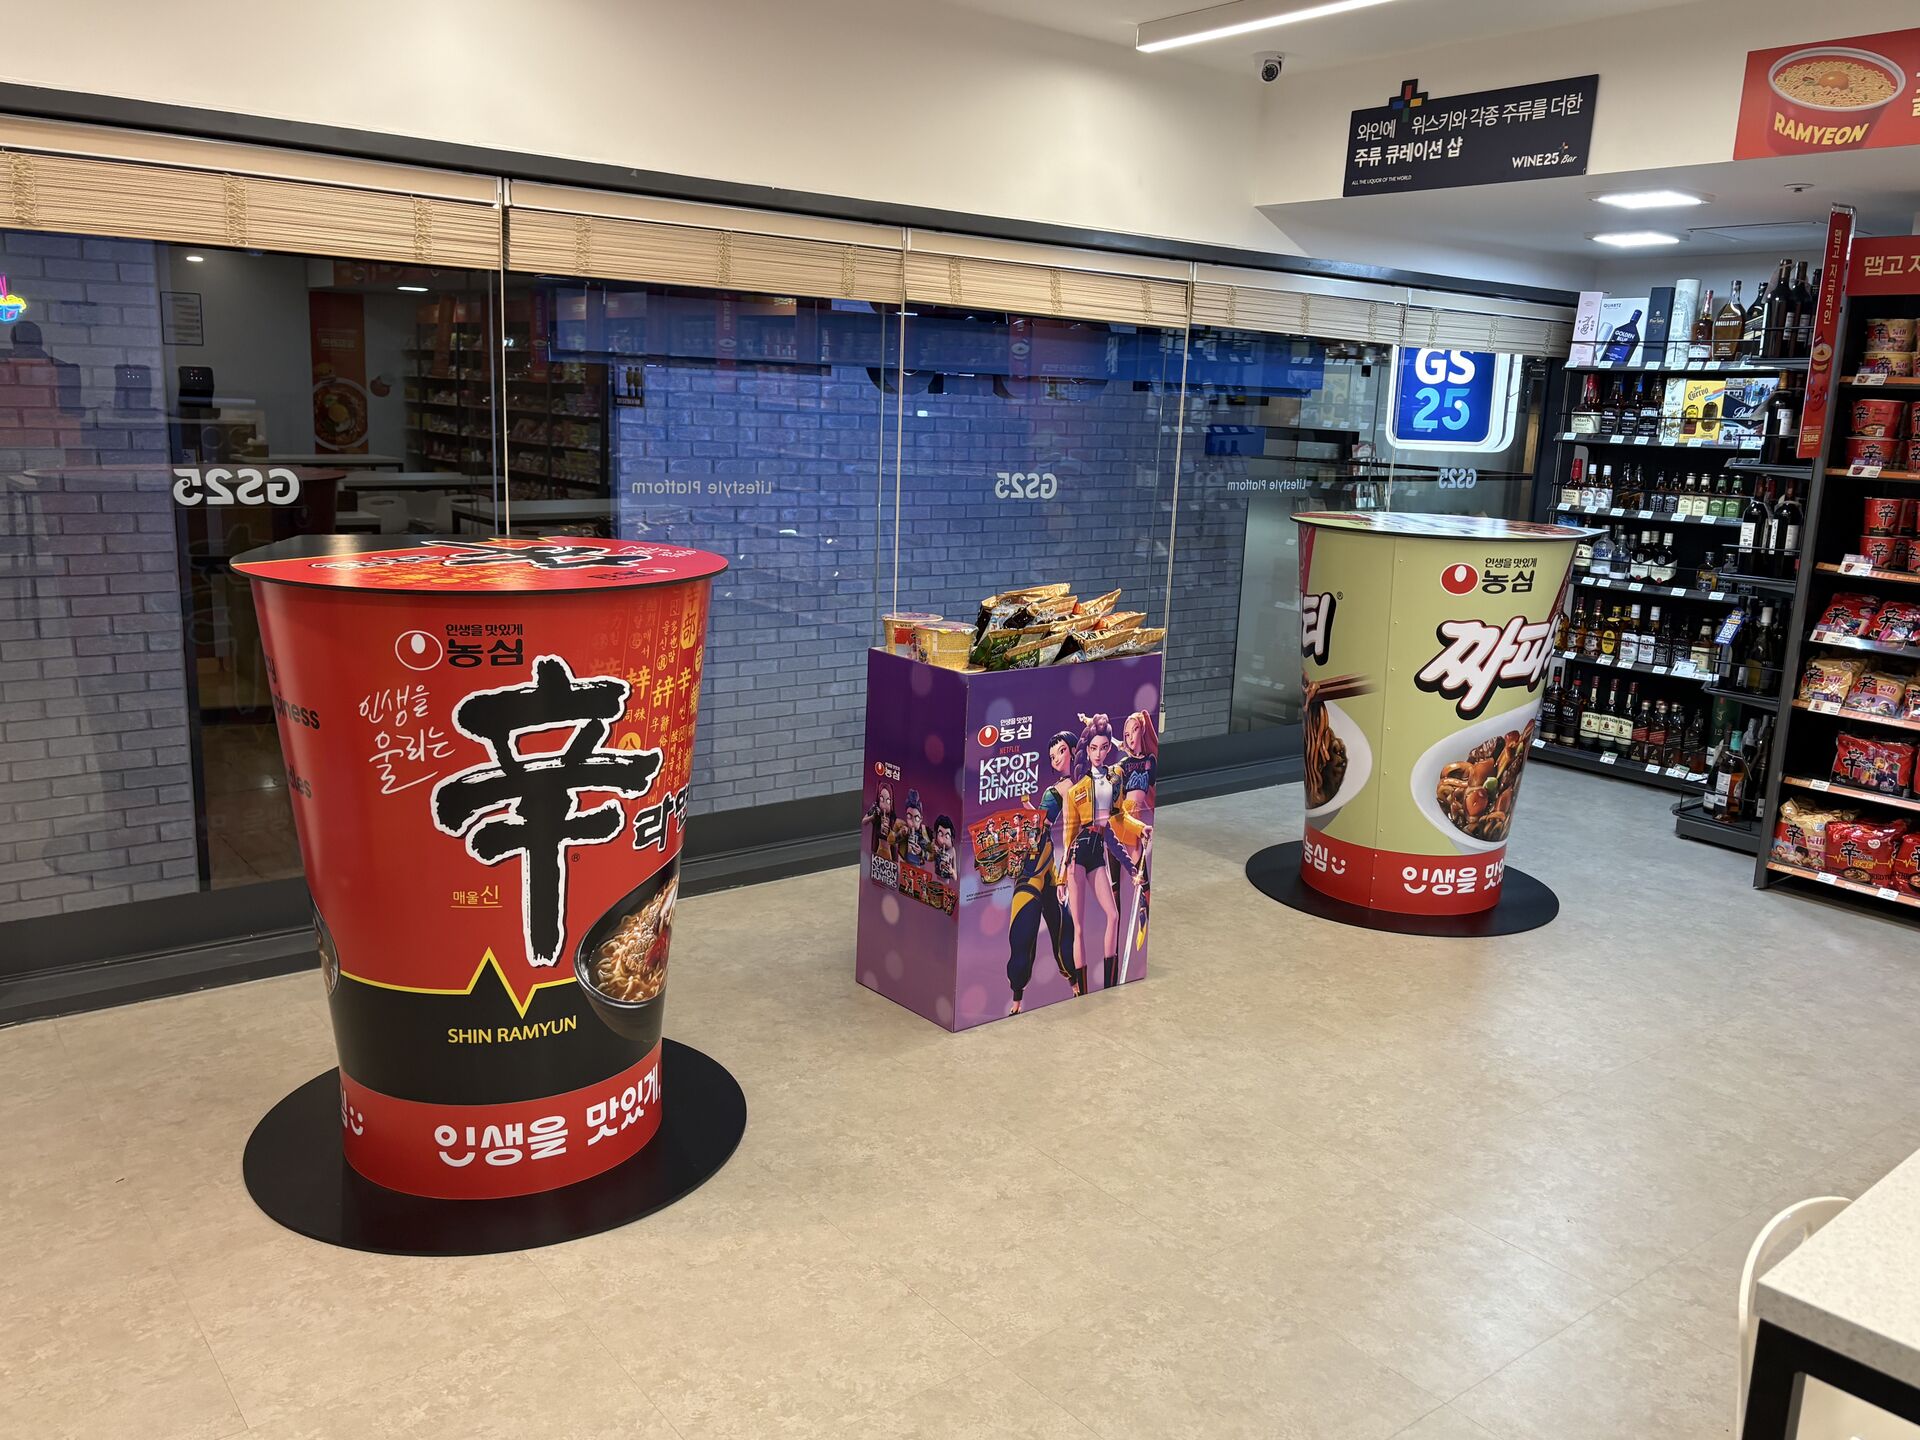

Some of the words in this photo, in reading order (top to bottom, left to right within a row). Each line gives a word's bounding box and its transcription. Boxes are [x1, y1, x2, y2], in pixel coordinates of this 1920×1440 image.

[1356, 118, 1397, 142] 와인에
[1411, 110, 1468, 136] 위스키와
[1469, 105, 1500, 128] 각종
[1501, 98, 1548, 124] 주류를
[1550, 92, 1584, 117] 더한
[1773, 111, 1870, 146] RAMYEON
[1354, 147, 1382, 168] 주류
[1385, 138, 1444, 165] 큐레이션
[1447, 136, 1464, 158] 샵
[1512, 151, 1559, 169] WINE25
[1560, 155, 1578, 165] Bar
[1864, 255, 1904, 277] 맵고
[1614, 330, 1636, 339] GOLDEN
[1414, 348, 1476, 385] GS
[1413, 387, 1471, 431] 25
[1855, 405, 1869, 427] 辛
[1878, 504, 1895, 526] 辛
[1484, 557, 1512, 569] 인생을
[1513, 557, 1538, 569] 맛있게
[1870, 542, 1888, 564] 辛
[1481, 570, 1535, 594] 농심
[446, 624, 483, 637] 인생을
[485, 624, 523, 637] 맛있게
[1878, 608, 1902, 630] 辛
[446, 638, 524, 668] 농심
[1805, 665, 1824, 687] 辛
[1858, 675, 1877, 694] 辛
[358, 684, 431, 727] 인생을
[999, 723, 1033, 743] 농심
[368, 726, 456, 795] 울리는
[999, 745, 1021, 755] NETFLIX
[884, 768, 901, 781] 농심
[1842, 748, 1865, 780] 辛
[979, 764, 1039, 790] DEMON
[979, 781, 1039, 806] HUNTERS
[430, 654, 664, 969] 辛
[1786, 823, 1804, 846] 辛
[1303, 834, 1329, 873] 농심
[1840, 840, 1861, 867] 辛
[870, 871, 898, 889] HUNTERS
[871, 863, 898, 880] DEMON
[1401, 866, 1478, 896] 인생을
[447, 1028, 492, 1044] SHIN
[497, 1014, 577, 1043] RAMYUN
[433, 1115, 569, 1168] 인생을
